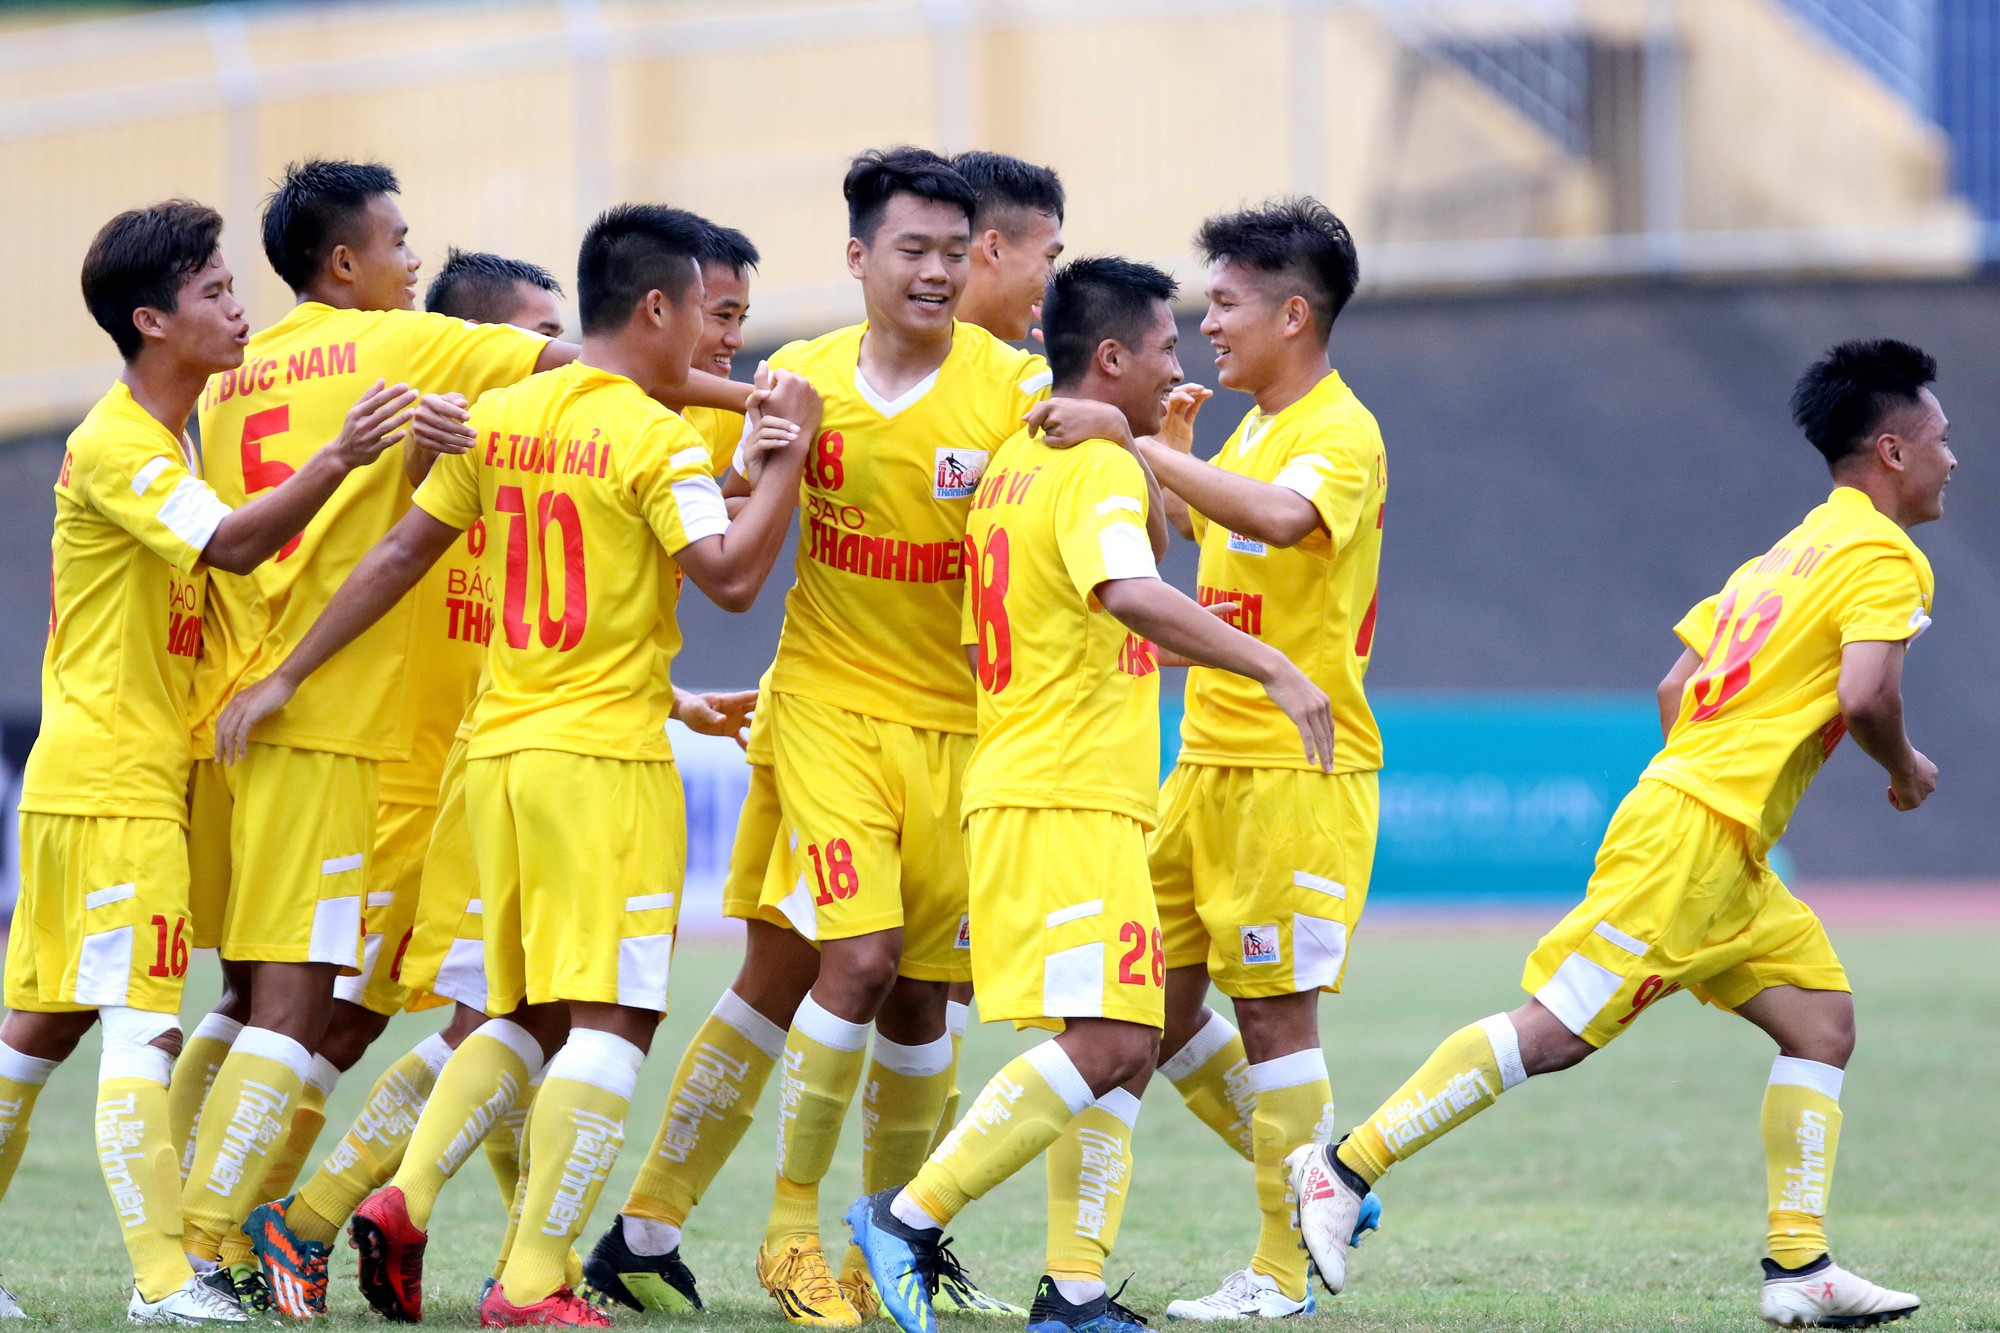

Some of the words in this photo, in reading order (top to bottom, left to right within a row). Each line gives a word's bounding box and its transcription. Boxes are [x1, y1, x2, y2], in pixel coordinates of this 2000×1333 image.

[286, 342, 356, 384] NAM
[240, 404, 304, 563] 5
[563, 428, 610, 478] HẢI
[804, 429, 844, 491] 18
[806, 495, 865, 530] BÁO
[495, 485, 588, 652] 10
[808, 837, 858, 906] 18
[148, 914, 188, 978] 16
[1118, 920, 1164, 989] 28
